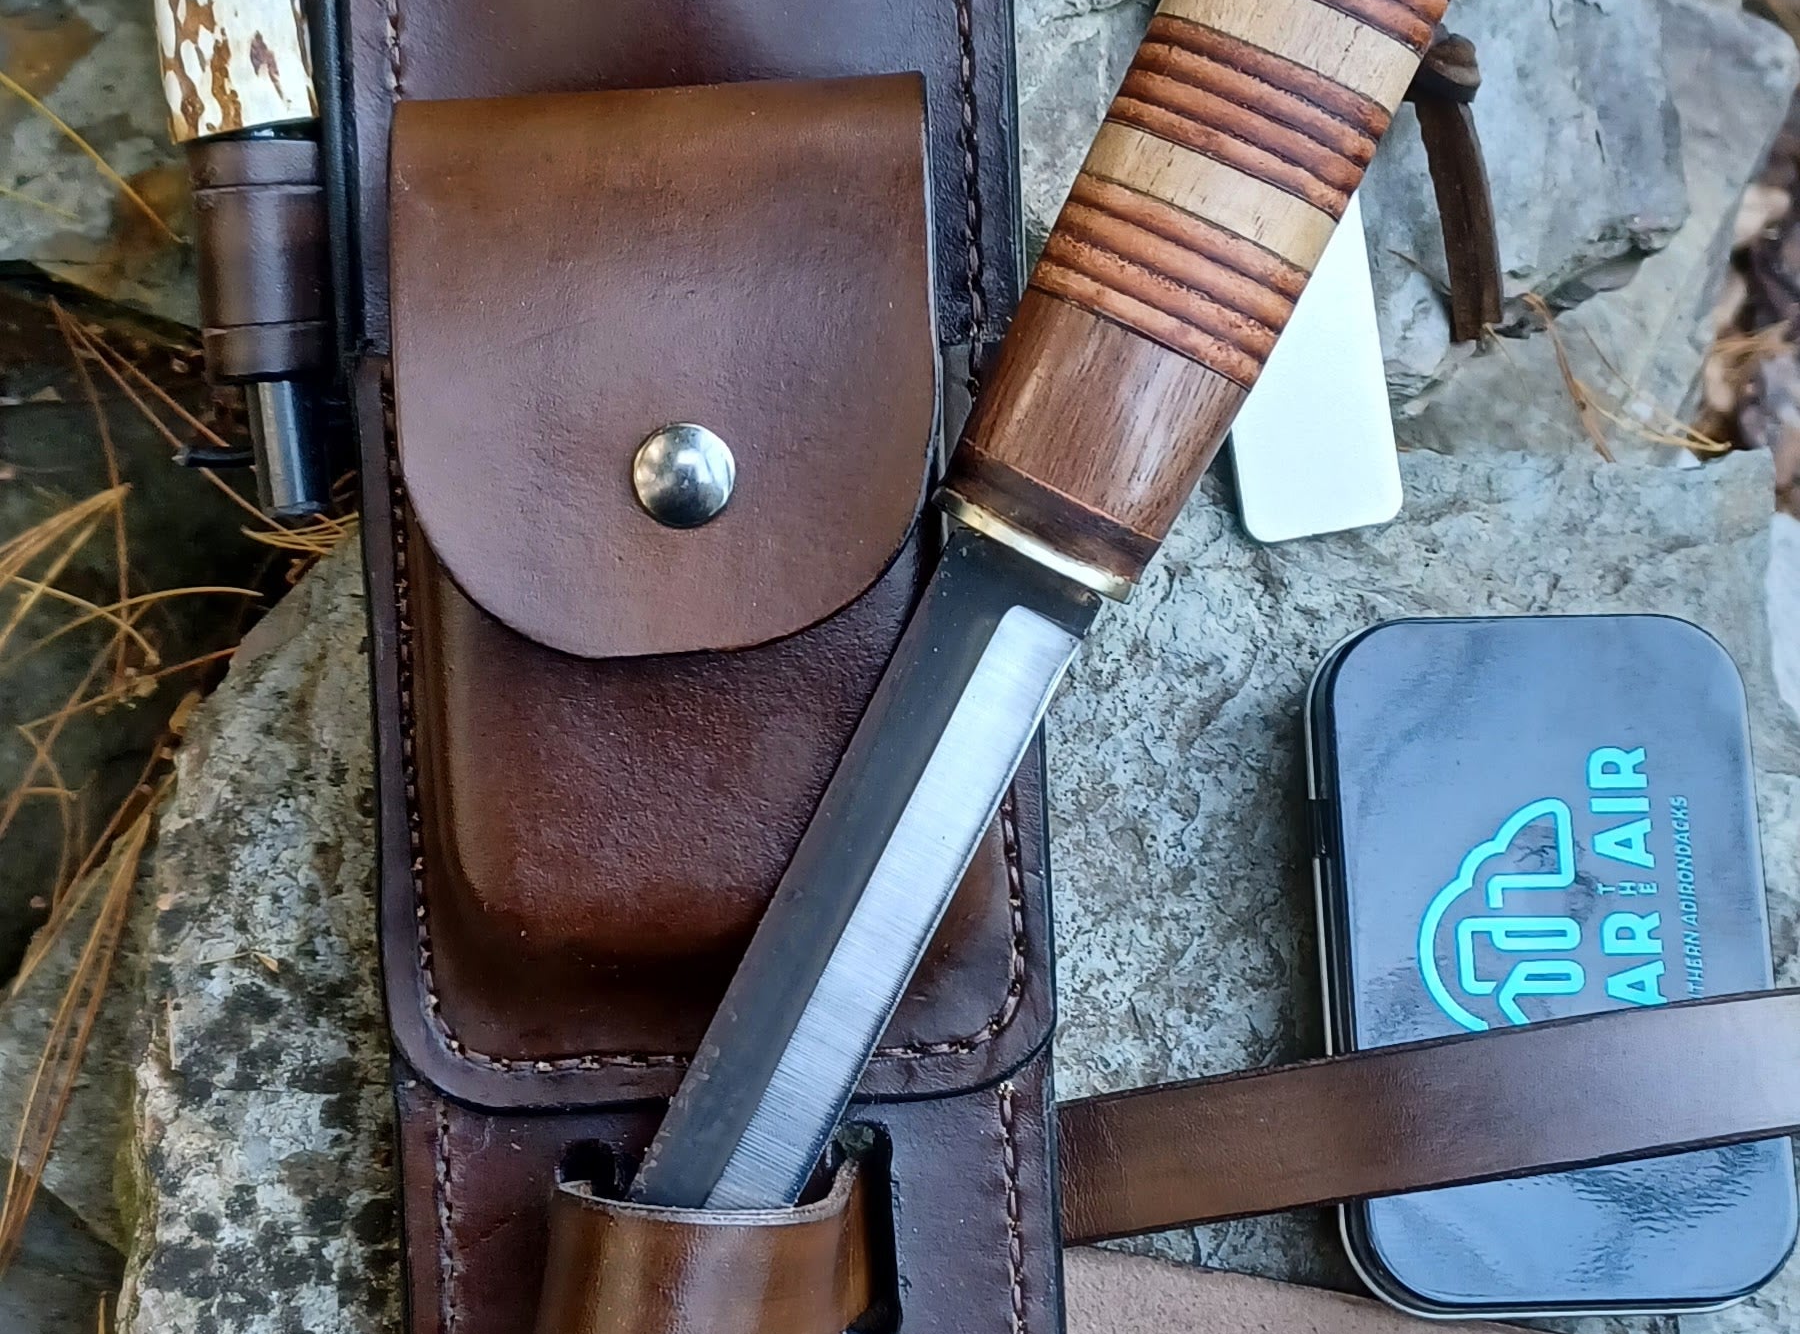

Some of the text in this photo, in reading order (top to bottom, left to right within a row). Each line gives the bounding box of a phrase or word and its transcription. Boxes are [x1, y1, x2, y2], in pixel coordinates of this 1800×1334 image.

[1586, 745, 1668, 1005] AR THE AIR
[1668, 794, 1705, 999] THERN ADIRONDACKS
